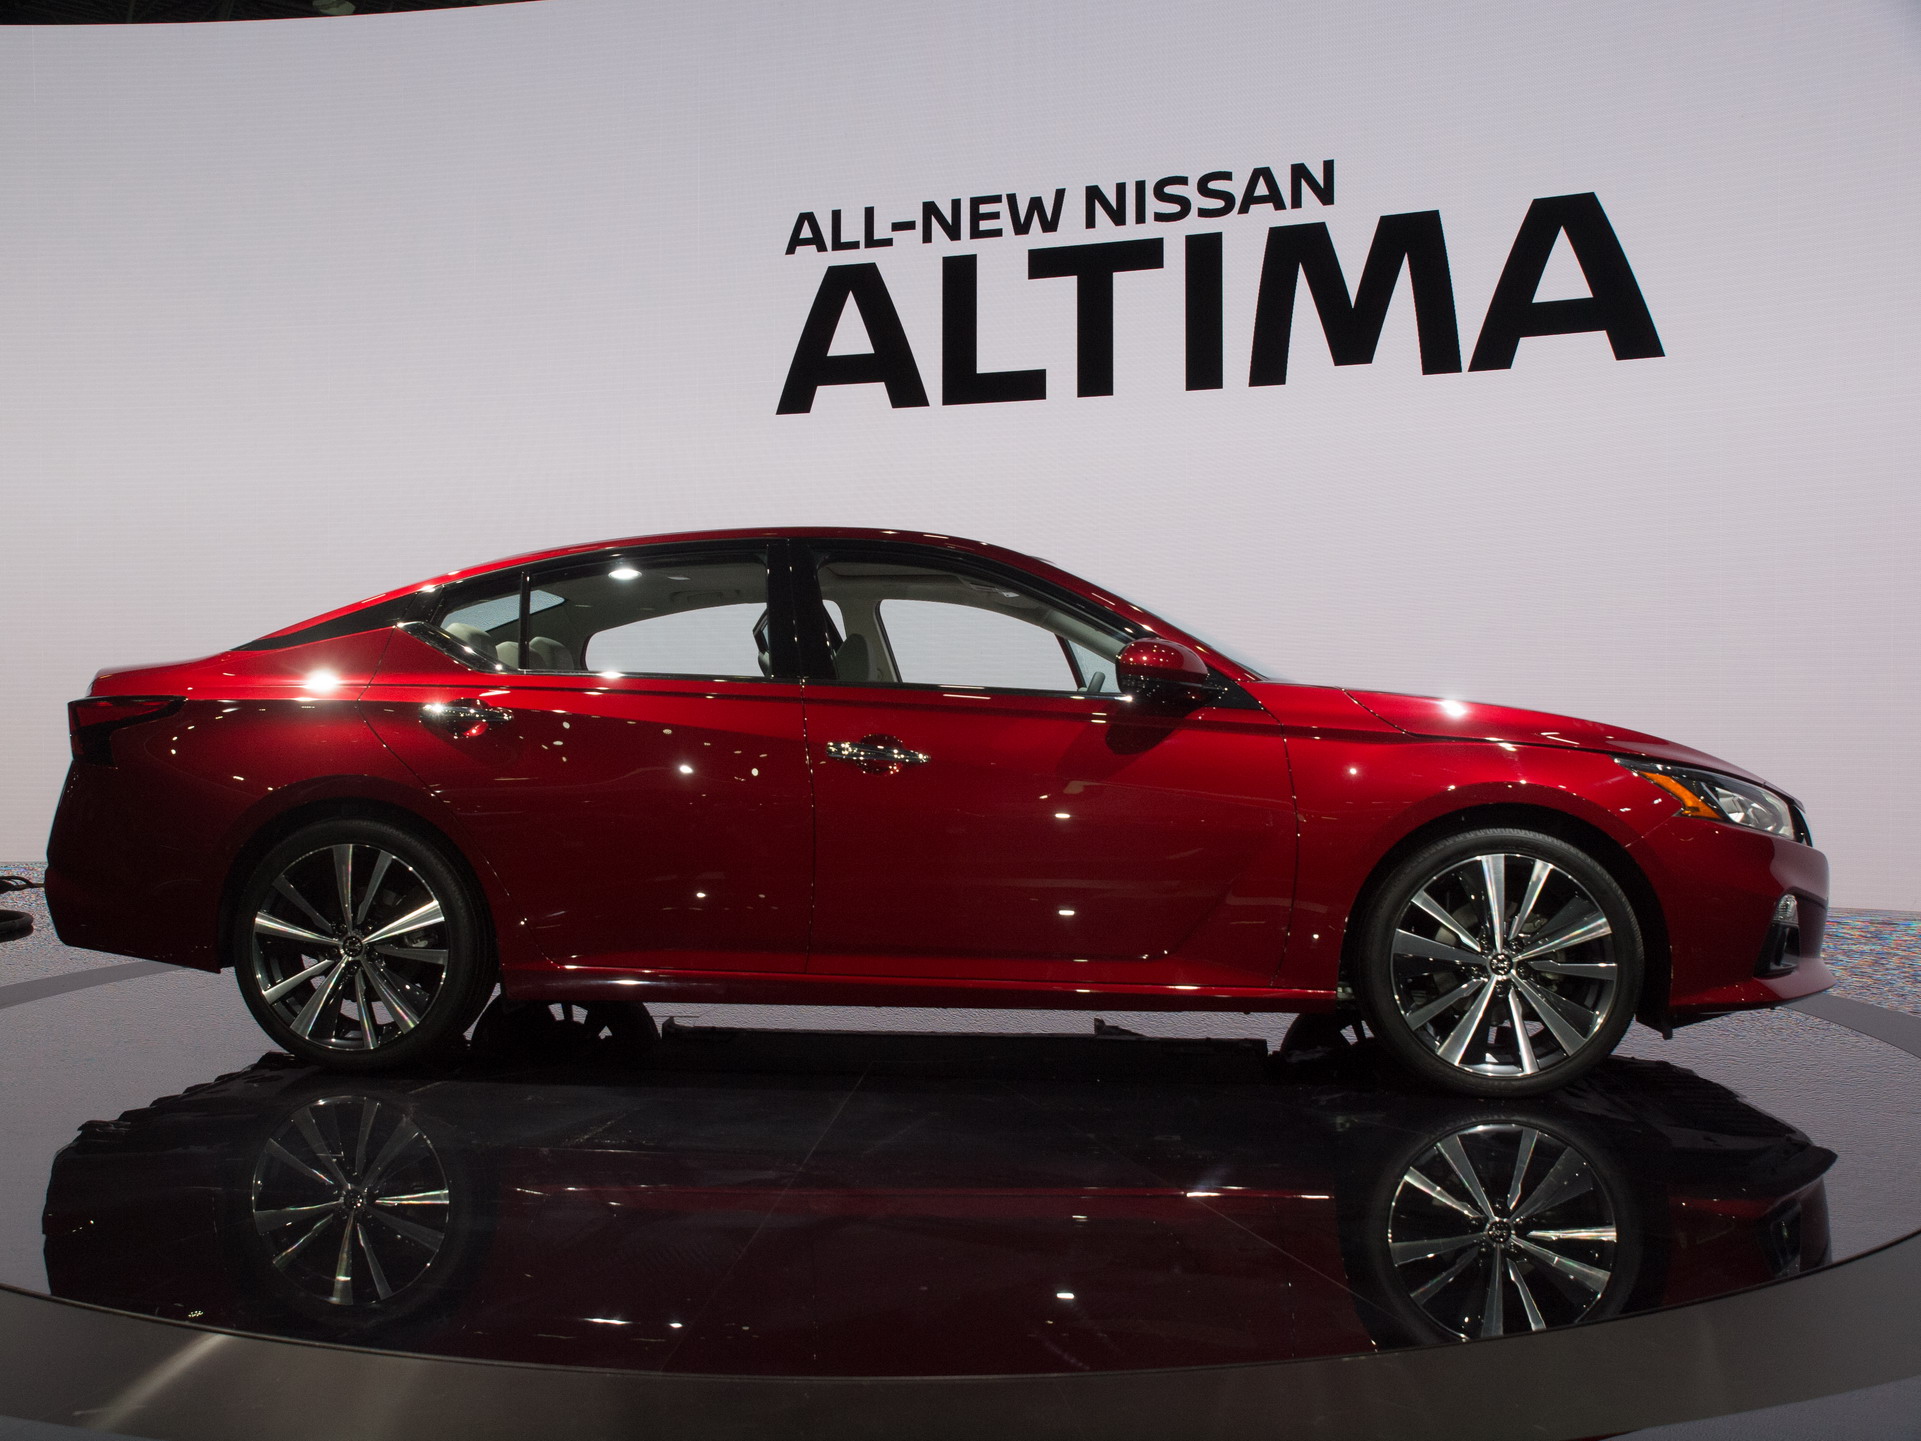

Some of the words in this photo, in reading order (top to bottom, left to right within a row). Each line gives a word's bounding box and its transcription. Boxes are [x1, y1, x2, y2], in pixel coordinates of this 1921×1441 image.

[786, 188, 1066, 255] ALL-NEW
[1086, 160, 1335, 230] NISSAN
[776, 192, 1666, 416] ALTIMA
